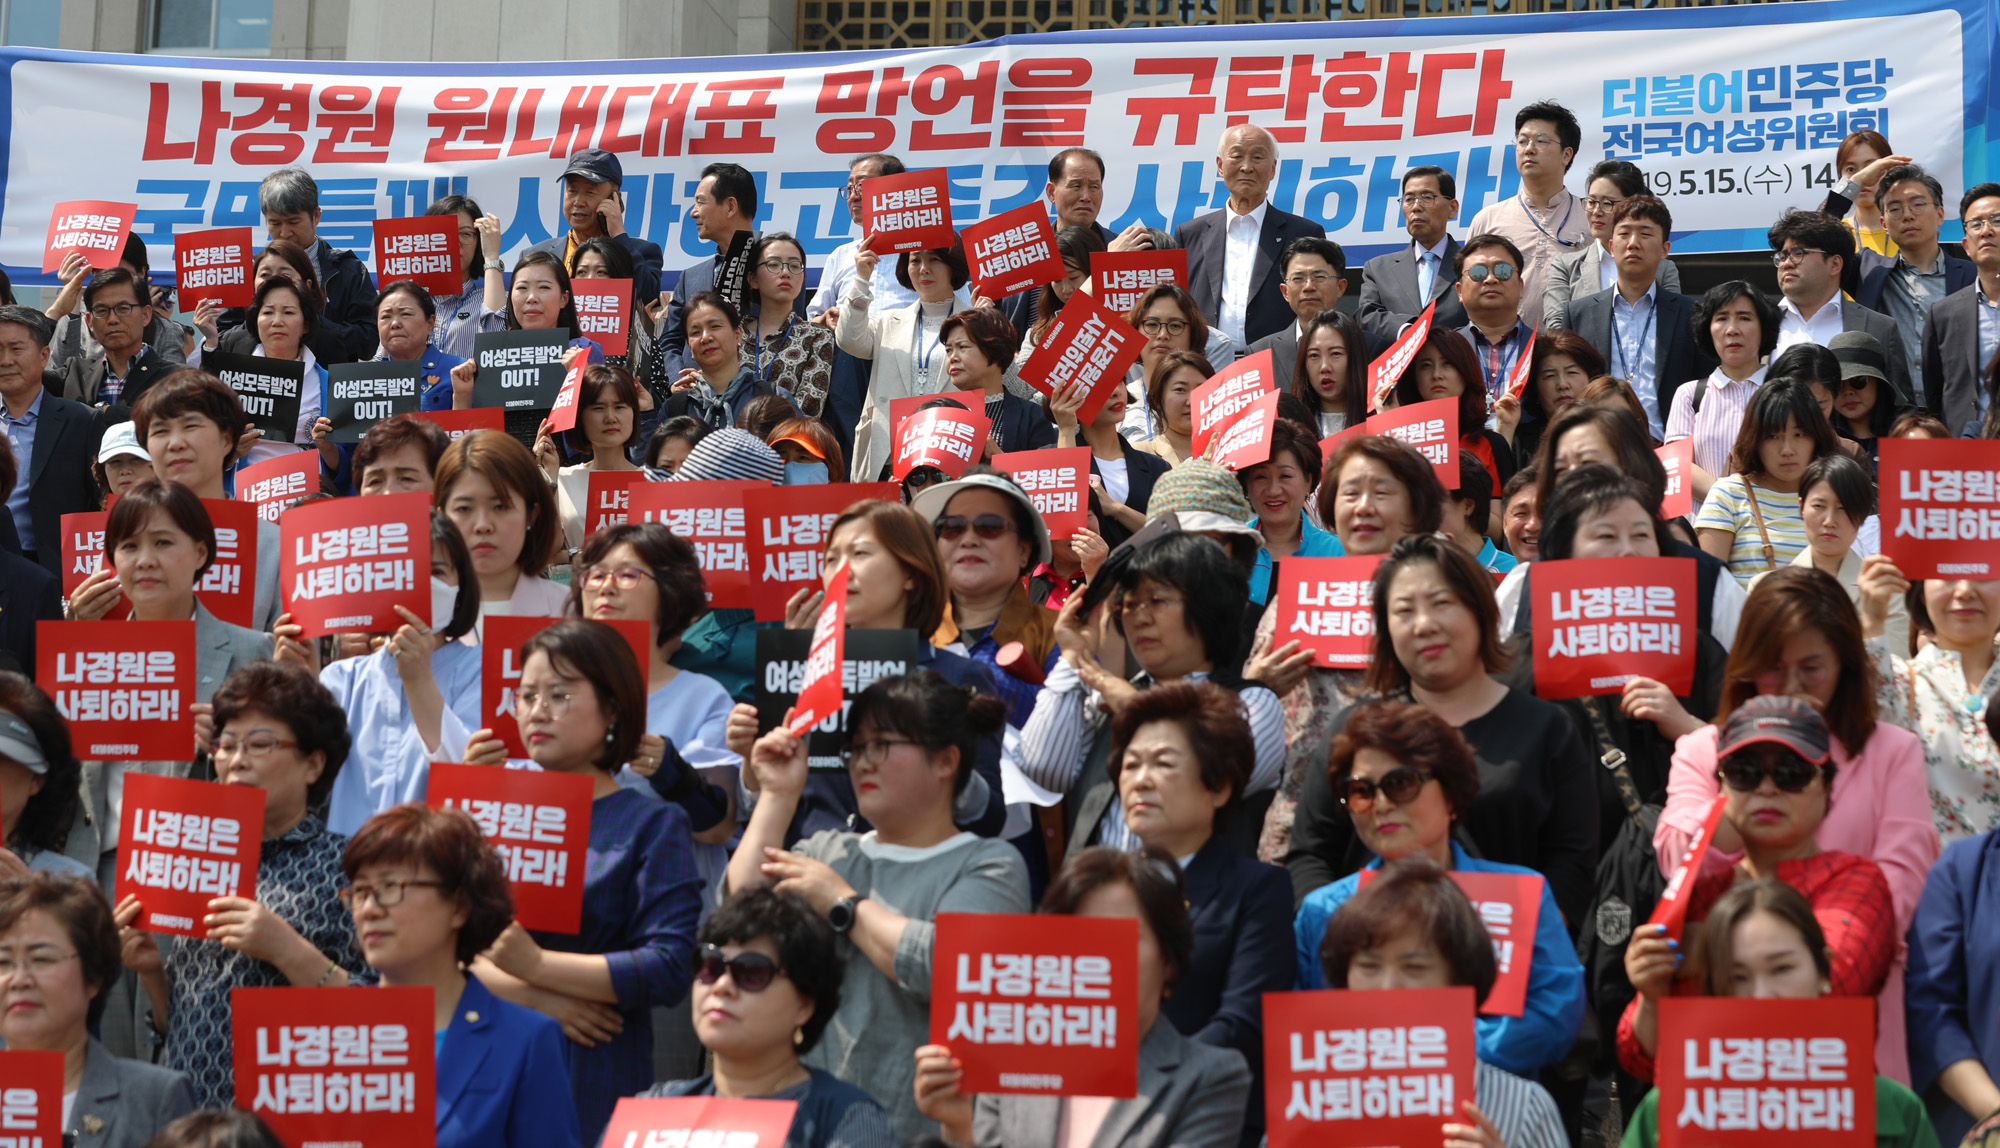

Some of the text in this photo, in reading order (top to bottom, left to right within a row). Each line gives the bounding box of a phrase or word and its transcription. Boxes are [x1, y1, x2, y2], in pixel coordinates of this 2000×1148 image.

[142, 48, 1513, 165] 나경원 원내대표 망언을 규탄한다
[1602, 58, 1894, 118] 더불어민주당
[1602, 107, 1889, 161] 전국여성위원회
[872, 186, 938, 212] 나경원은
[57, 214, 122, 233] 나경원은
[871, 208, 943, 234] 사퇴하라!
[974, 221, 1041, 260] 나경원은
[51, 232, 119, 251] 사퇴하라!
[182, 245, 241, 268] 나경원은
[384, 233, 448, 255] 나경원은
[182, 266, 245, 289] 사퇴하라!
[382, 254, 452, 276] 사퇴하라!
[977, 242, 1051, 281] 사퇴하라!
[480, 345, 563, 368] 여성모독발언
[1044, 312, 1107, 390] 사퇴하라!
[219, 370, 298, 398] 여성모독발언
[333, 378, 415, 399] 여성모독발언
[501, 368, 540, 389] OUT!
[1200, 369, 1261, 416] 나경원은
[354, 401, 393, 420] OUT!
[1900, 470, 2000, 503] 나경원
[296, 522, 409, 566] 나경원은
[291, 559, 415, 603] 사퇴하라!
[1551, 585, 1676, 621] 나경원은
[1548, 622, 1681, 658] 사퇴하라!
[56, 651, 176, 684] 나경원은
[55, 689, 180, 722] 사퇴하라!
[132, 808, 241, 856] 나경원은
[125, 849, 241, 897] 사퇴하라!
[956, 953, 1112, 999] 나경원은
[947, 1001, 1117, 1048] 사퇴하라!
[256, 1024, 409, 1067] 나경원은
[1289, 1025, 1448, 1073] 나경원은
[1684, 1038, 1848, 1082] 나경원은
[253, 1072, 415, 1114] 사퇴하라!
[1284, 1074, 1455, 1122] 사퇴하라!
[1677, 1087, 1855, 1131] 사퇴하라!
